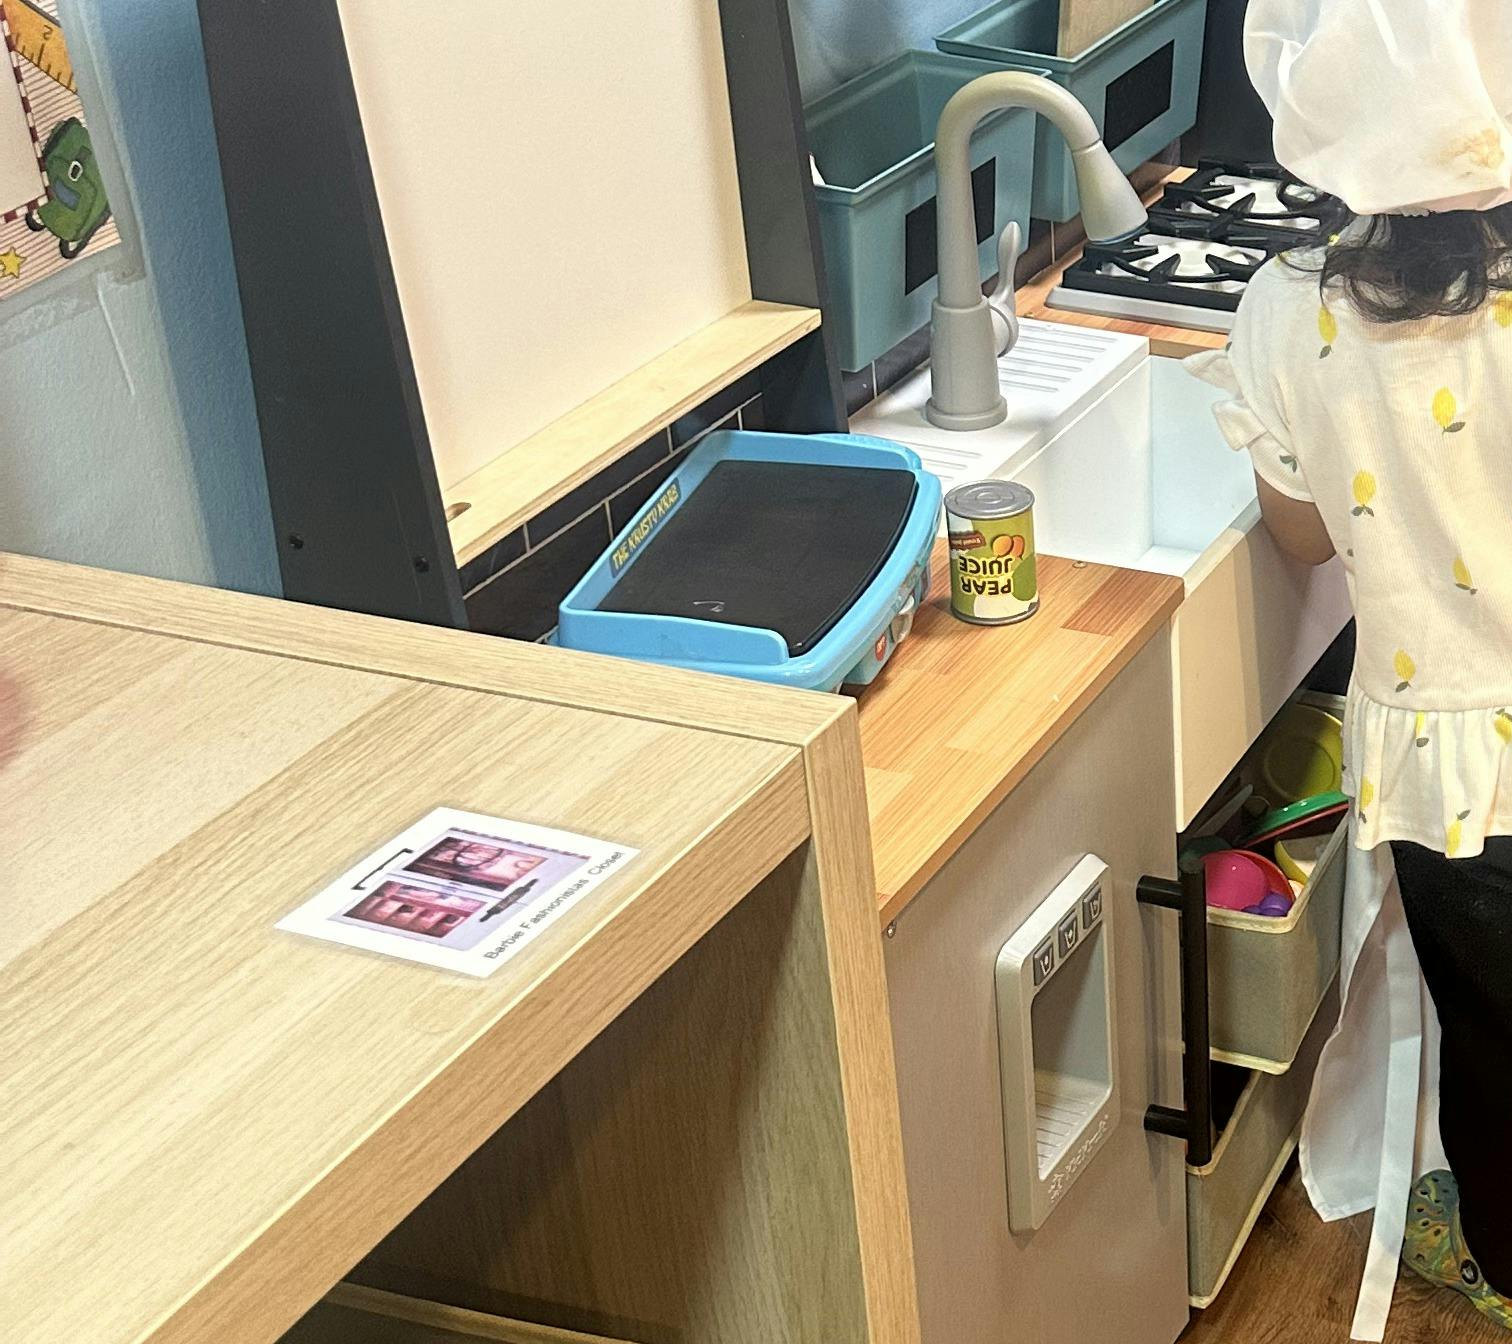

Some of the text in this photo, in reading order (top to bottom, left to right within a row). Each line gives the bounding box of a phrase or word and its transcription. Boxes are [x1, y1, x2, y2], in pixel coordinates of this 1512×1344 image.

[612, 541, 630, 570] THE
[959, 556, 1013, 575] JUICE
[961, 576, 1012, 595] PEAR
[484, 930, 525, 960] Barbie
[587, 851, 624, 876] Closet
